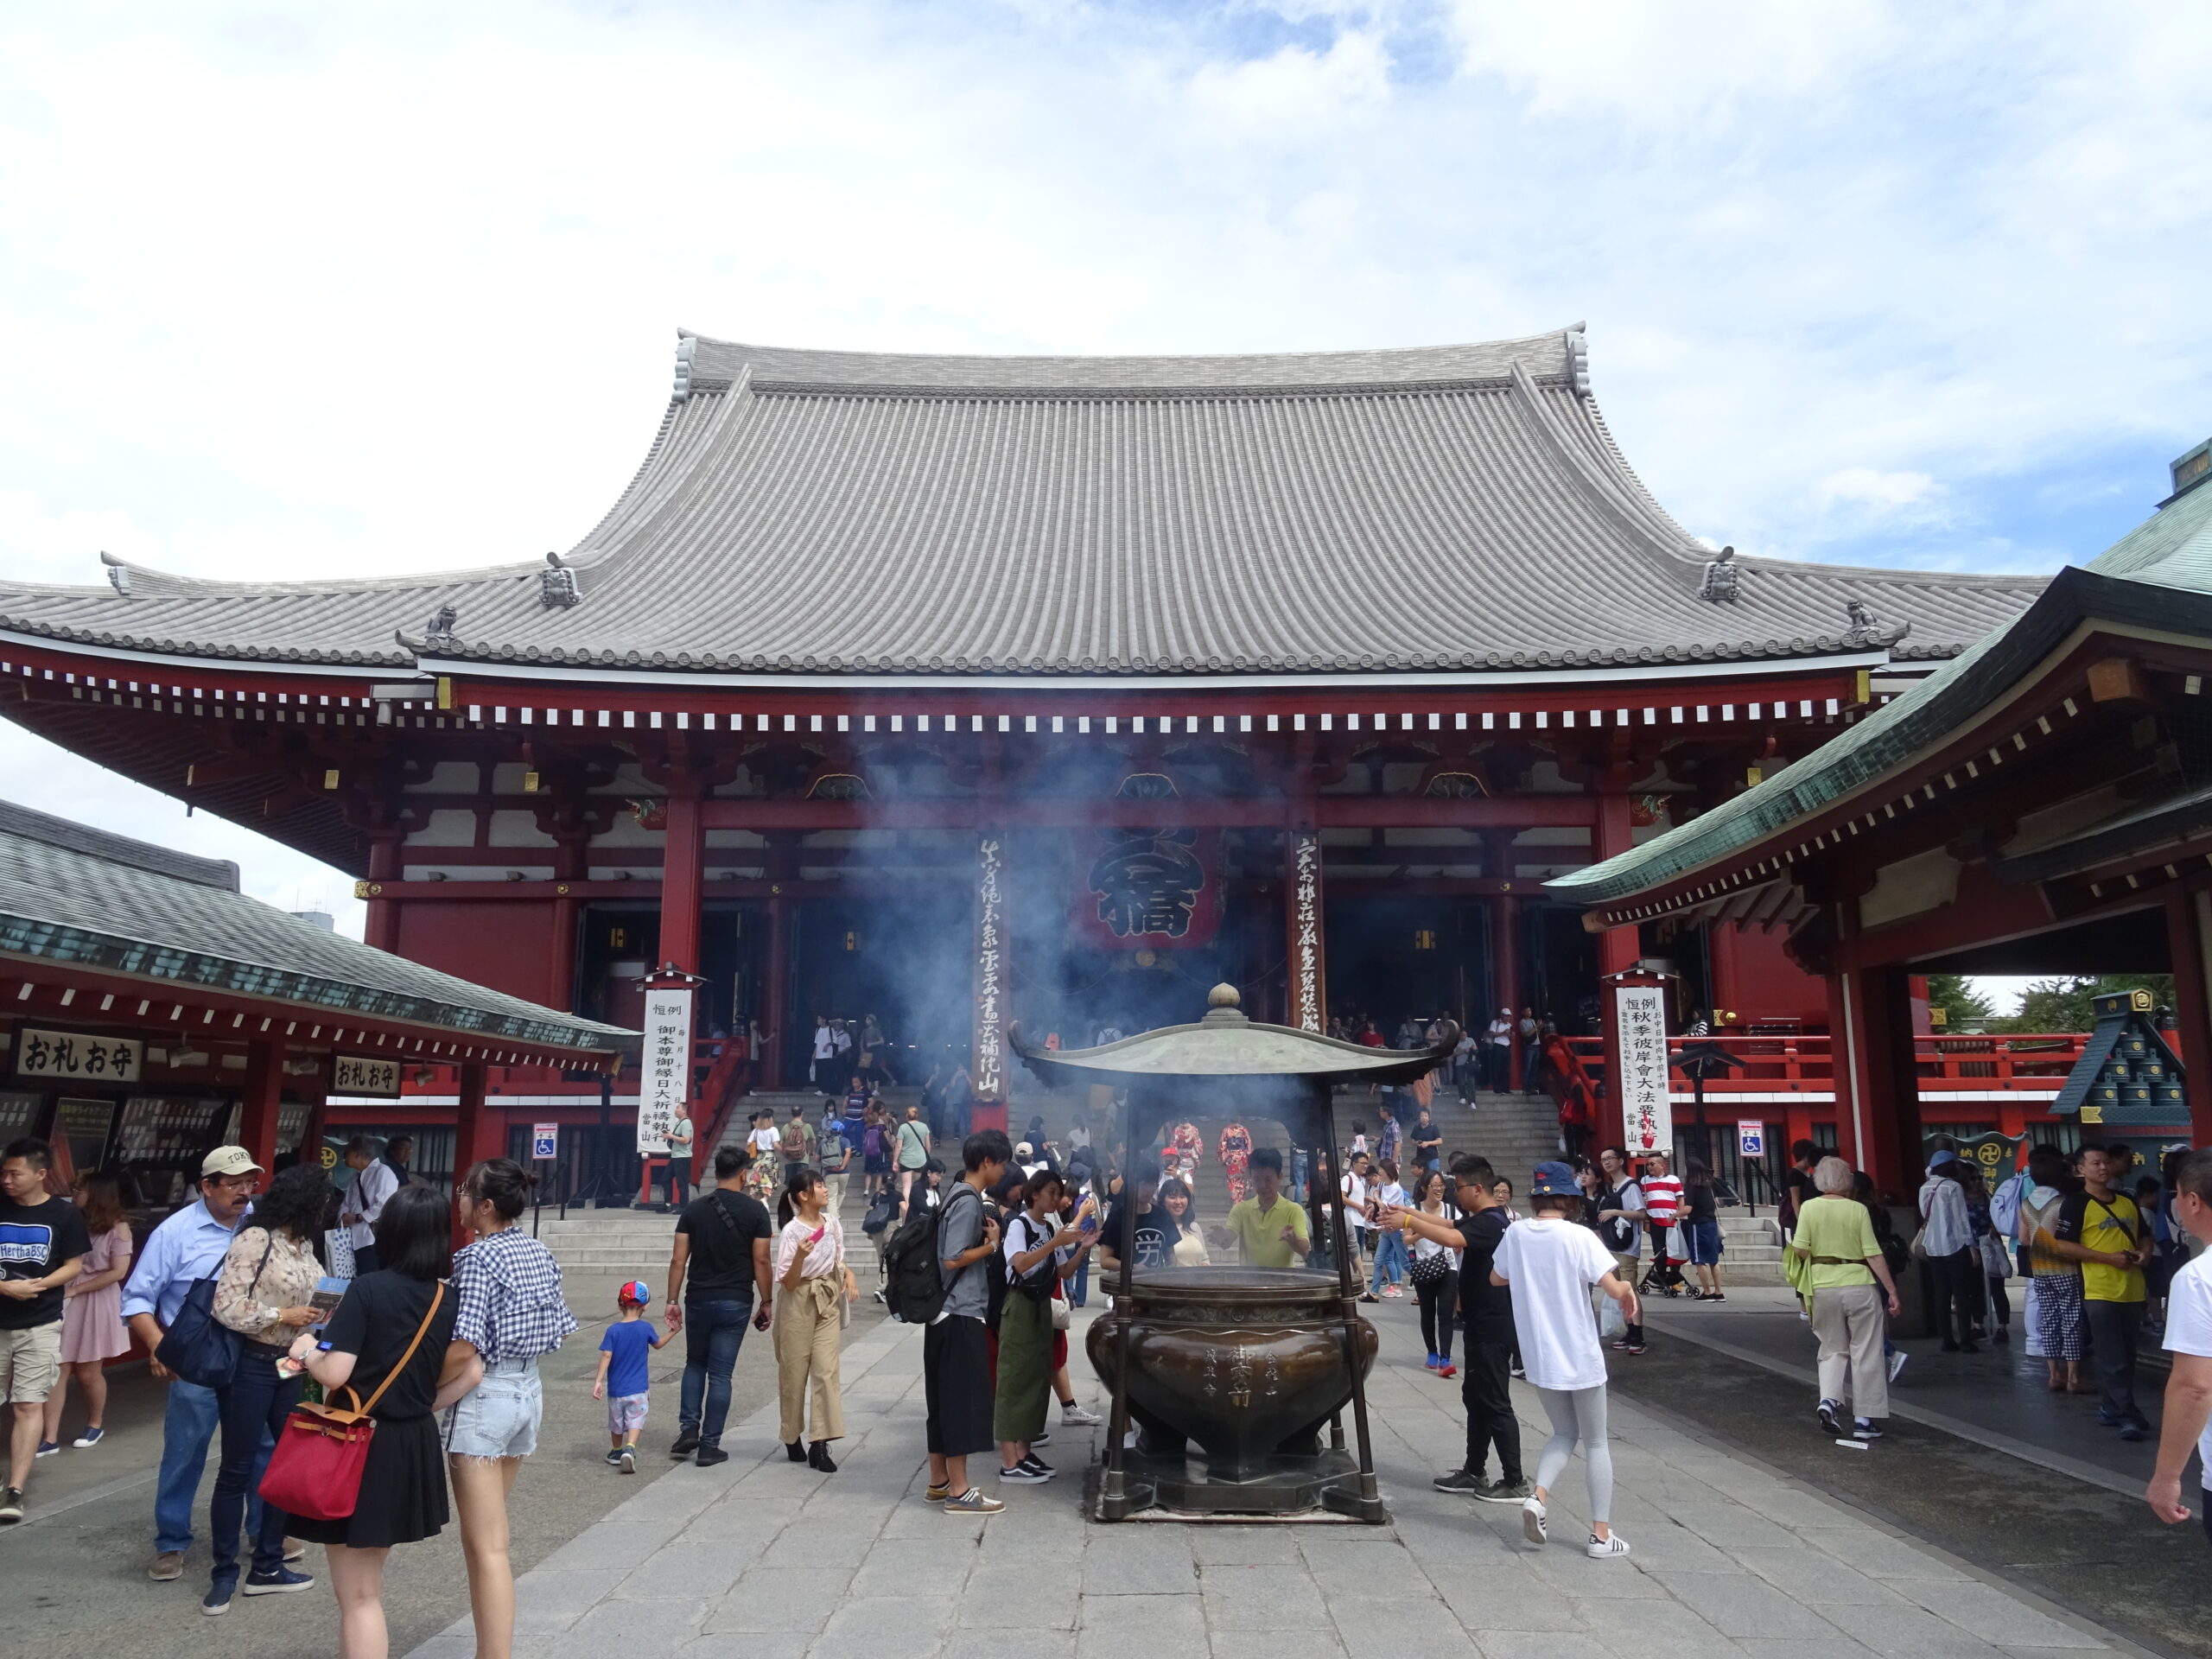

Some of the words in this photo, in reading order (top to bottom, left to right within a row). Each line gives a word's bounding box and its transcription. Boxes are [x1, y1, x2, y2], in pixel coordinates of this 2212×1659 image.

[652, 1004, 682, 1015] 恒例
[1625, 996, 1656, 1010] 恒例
[25, 1034, 132, 1077] お札お守
[338, 1061, 393, 1090] お札お守
